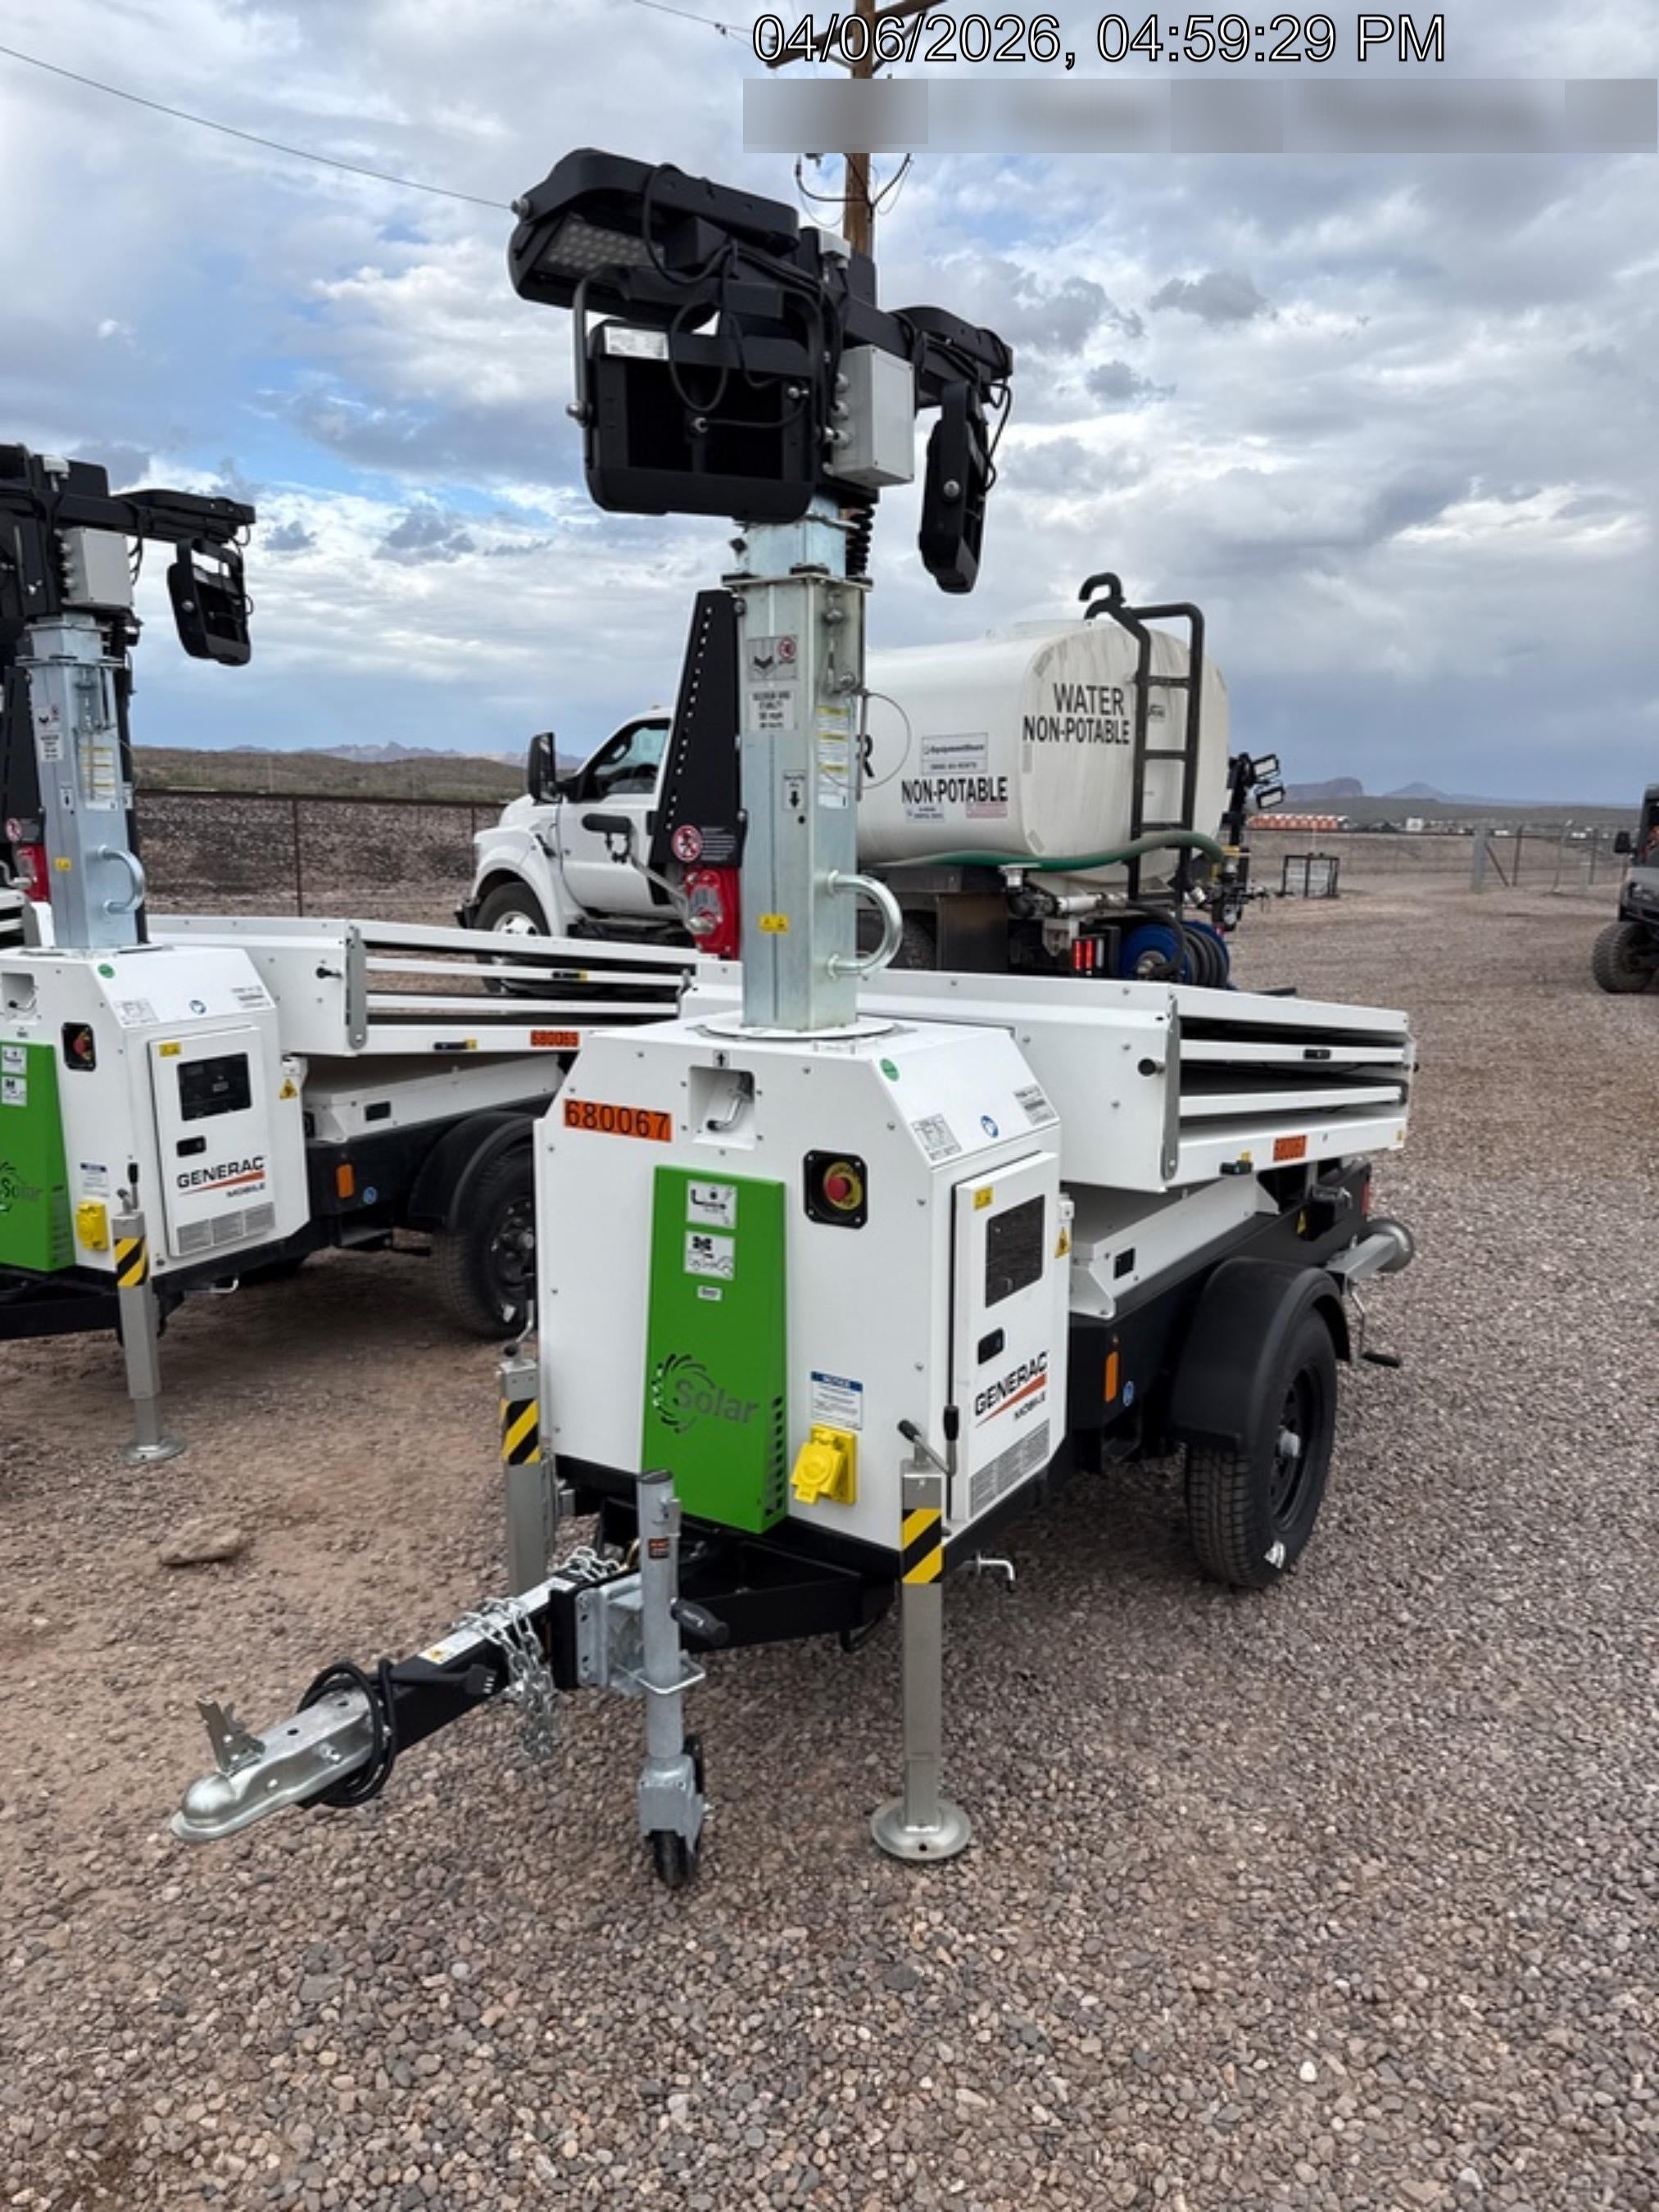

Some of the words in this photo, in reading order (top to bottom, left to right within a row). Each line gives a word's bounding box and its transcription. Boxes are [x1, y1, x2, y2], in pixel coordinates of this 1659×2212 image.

[1053, 682, 1125, 716] WATER
[1022, 715, 1131, 745] NON-POTABLE
[901, 776, 1009, 804] NON-POTABLE
[565, 1099, 671, 1142] 680067
[176, 1155, 265, 1189] GENERAC
[975, 1351, 1048, 1416] GENERAC
[676, 1379, 759, 1424] Solar
